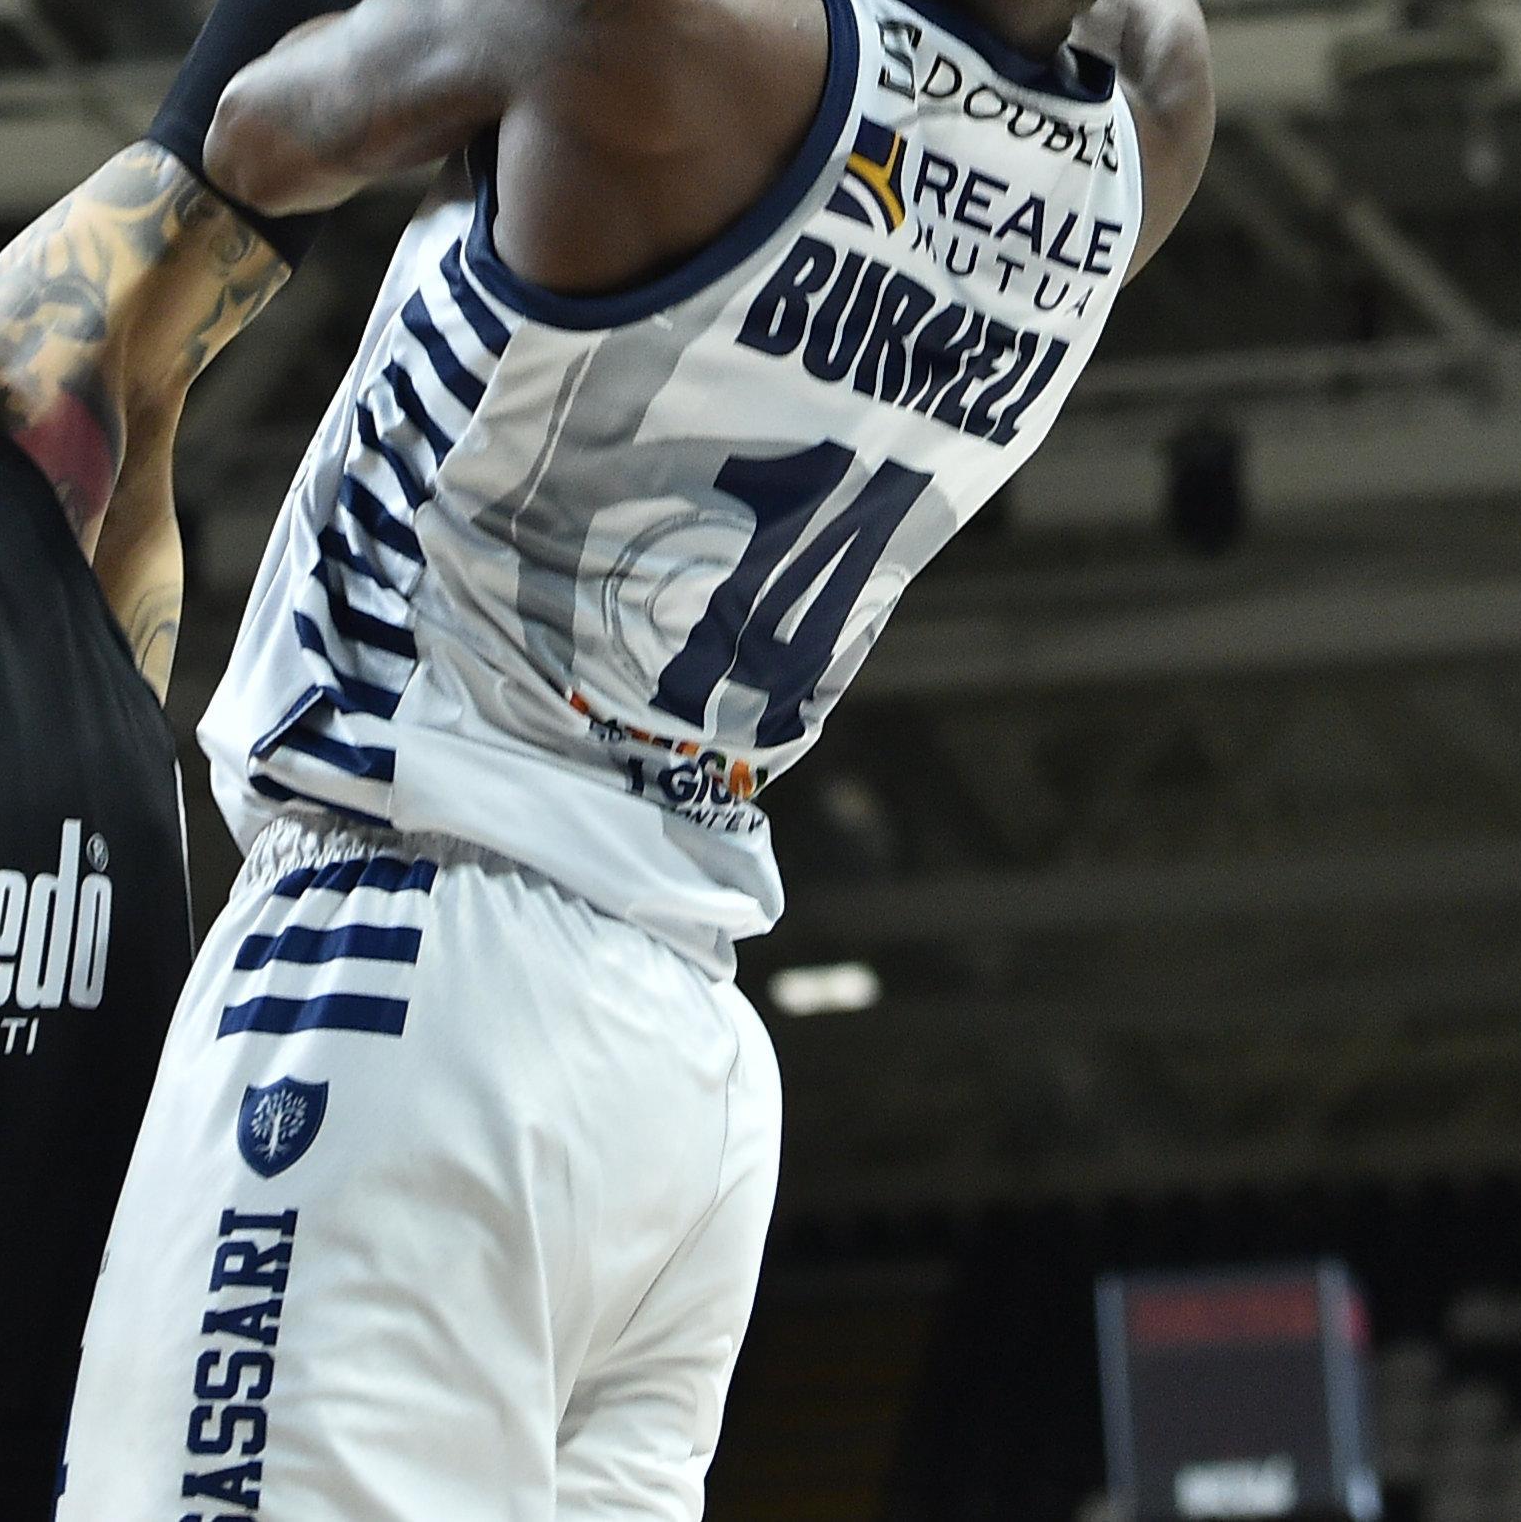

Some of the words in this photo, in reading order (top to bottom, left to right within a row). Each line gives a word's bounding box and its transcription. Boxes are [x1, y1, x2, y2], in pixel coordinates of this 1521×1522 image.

[734, 233, 1071, 447] BURNELL
[912, 146, 1124, 276] REALE
[648, 439, 937, 748] 14
[178, 1208, 300, 1522] ASSARI
